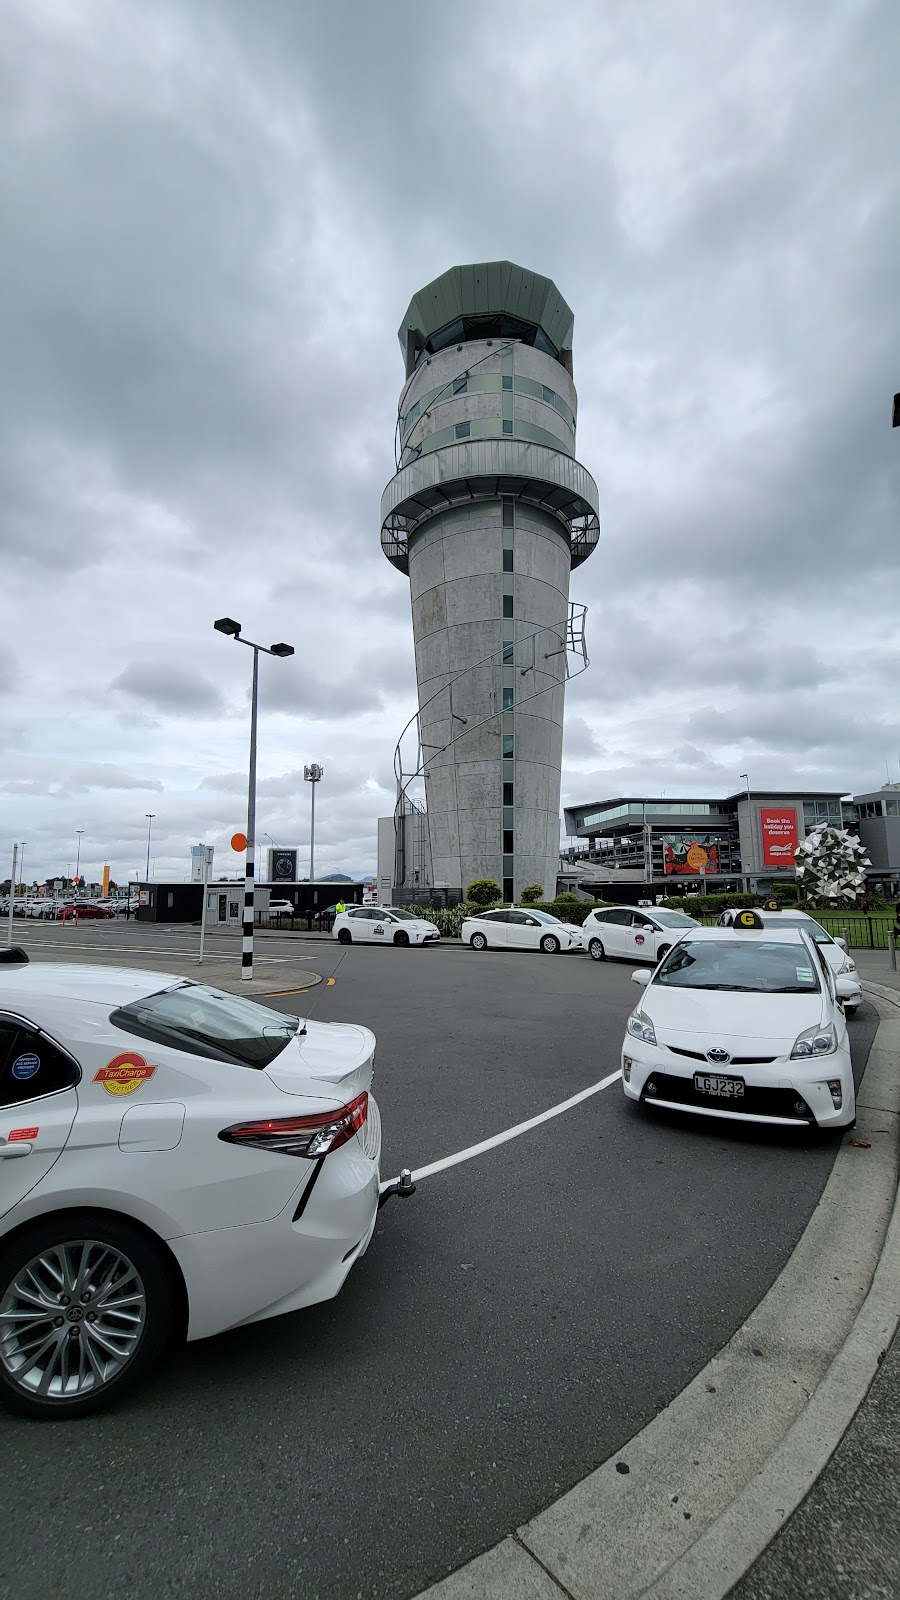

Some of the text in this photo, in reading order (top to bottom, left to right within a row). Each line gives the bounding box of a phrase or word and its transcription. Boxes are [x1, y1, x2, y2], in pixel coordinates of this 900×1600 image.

[769, 901, 778, 910] G
[741, 913, 754, 925] G
[105, 1069, 146, 1078] TaxiCharge
[110, 1081, 138, 1092] PARTNER
[696, 1077, 743, 1095] LGJ232
